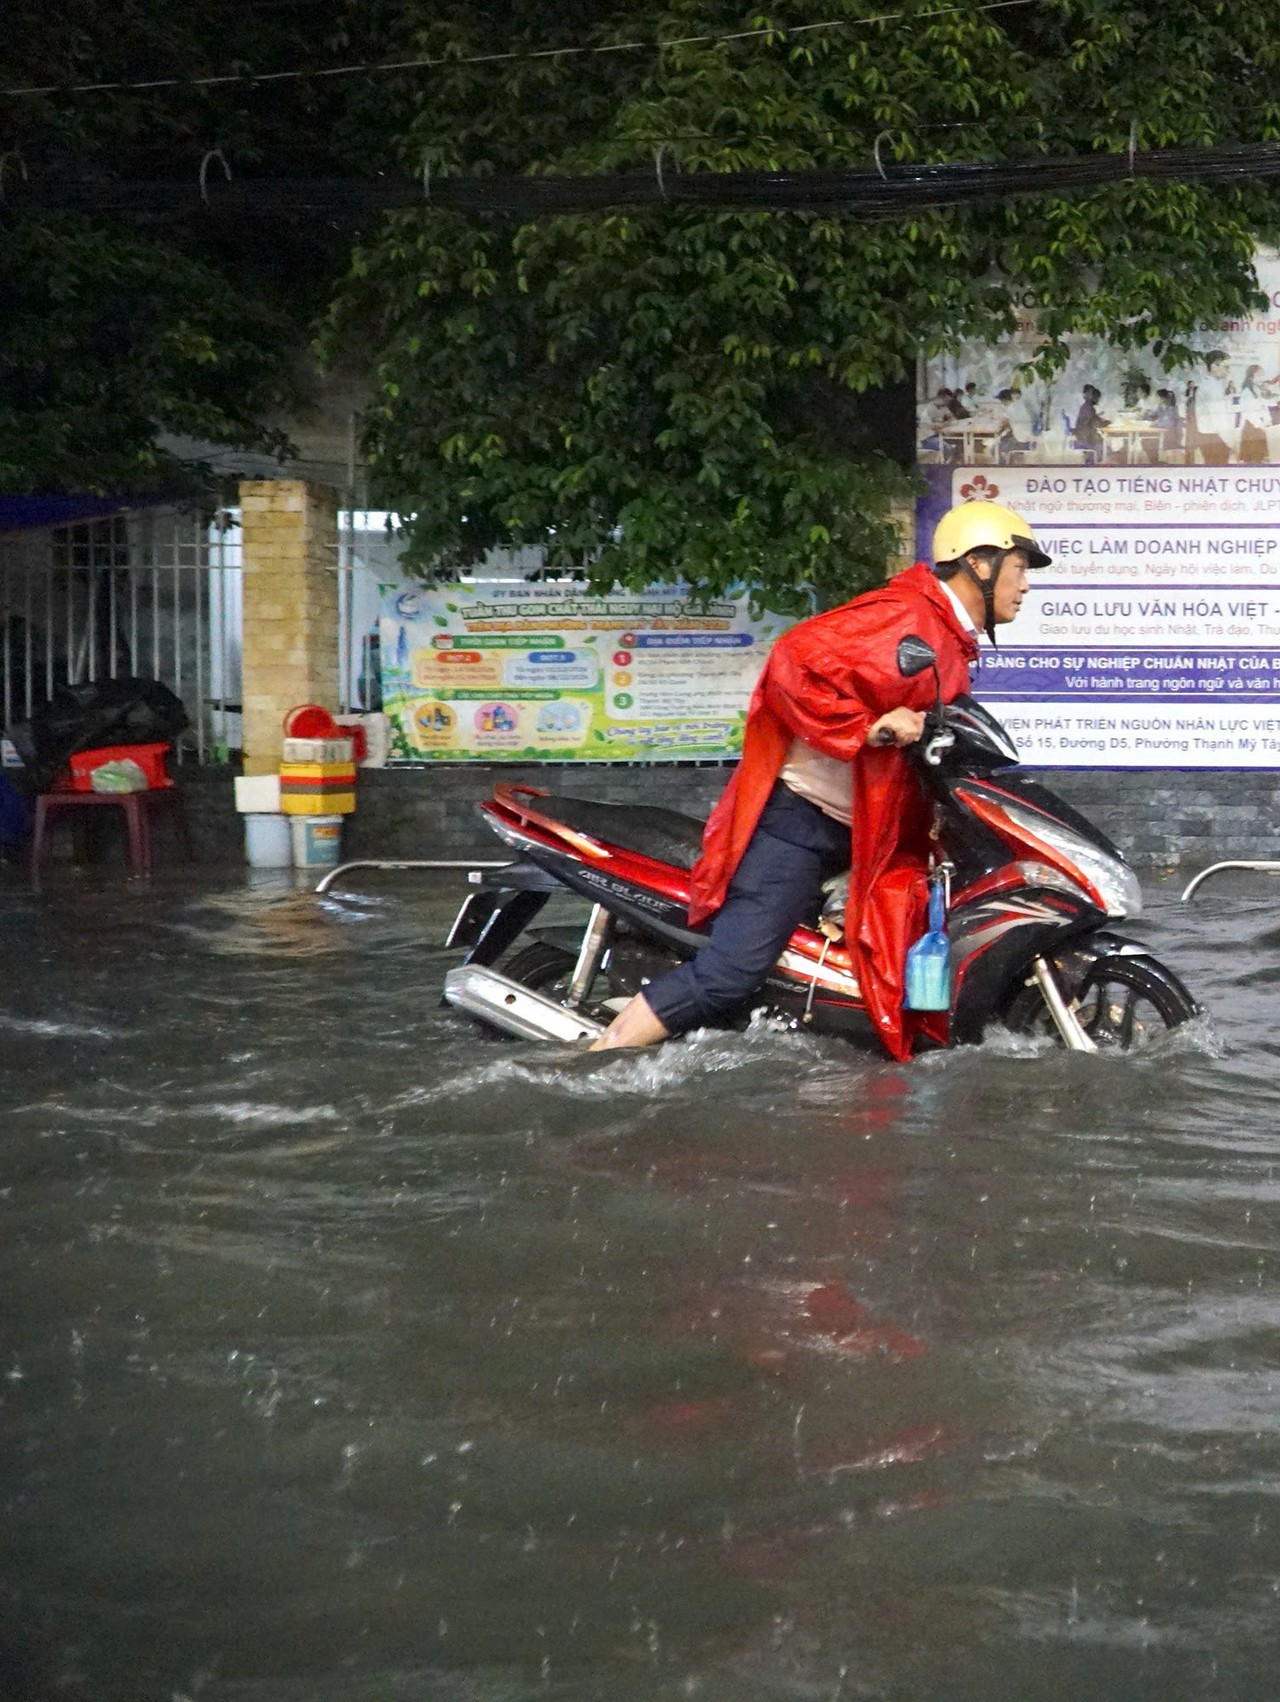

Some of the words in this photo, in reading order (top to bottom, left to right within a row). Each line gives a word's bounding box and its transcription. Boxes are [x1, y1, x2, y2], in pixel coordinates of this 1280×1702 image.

[1026, 475, 1066, 494] ĐÀO
[1073, 479, 1110, 498] TẠO
[1117, 475, 1172, 494] TIẾNG
[1178, 475, 1229, 496] NHẬT
[1042, 538, 1083, 558] VIỆC
[1090, 536, 1128, 554] LÀM
[1135, 540, 1201, 555] DOANH
[1207, 538, 1278, 558] NGHIỆP
[1041, 602, 1087, 617] GIAO
[1094, 602, 1133, 617] LƯU
[1138, 598, 1176, 617] VĂN
[1183, 598, 1223, 617] HÓA
[1228, 601, 1269, 620] VIỆT
[1029, 657, 1060, 670] CHO
[1063, 657, 1085, 673] SỰ
[1088, 655, 1141, 673] NGHIỆP
[1144, 654, 1193, 670] CHUẨN
[1197, 656, 1236, 673] NHẬT
[1239, 654, 1268, 670] CỦA
[1066, 676, 1087, 689] Với
[1091, 676, 1123, 689] hành
[1127, 677, 1159, 693] trang
[1163, 677, 1195, 693] ngôn
[1198, 678, 1224, 693] ngữ
[1227, 678, 1242, 690] và
[1246, 678, 1268, 690] văn
[999, 718, 1030, 733] VIỆN
[1035, 716, 1072, 731] PHÁT
[1076, 716, 1117, 731] TRIỂN
[1121, 716, 1171, 731] NGUỒN
[1176, 717, 1215, 731] NHÂN
[1220, 719, 1249, 734] LỰC
[1016, 735, 1033, 748] Số
[1038, 738, 1056, 750] 15,
[1060, 737, 1106, 752] Đường
[1110, 738, 1131, 751] D5,
[1135, 738, 1189, 753] Phường
[1194, 738, 1234, 753] Thạnh
[1238, 739, 1257, 753] Mỹ
